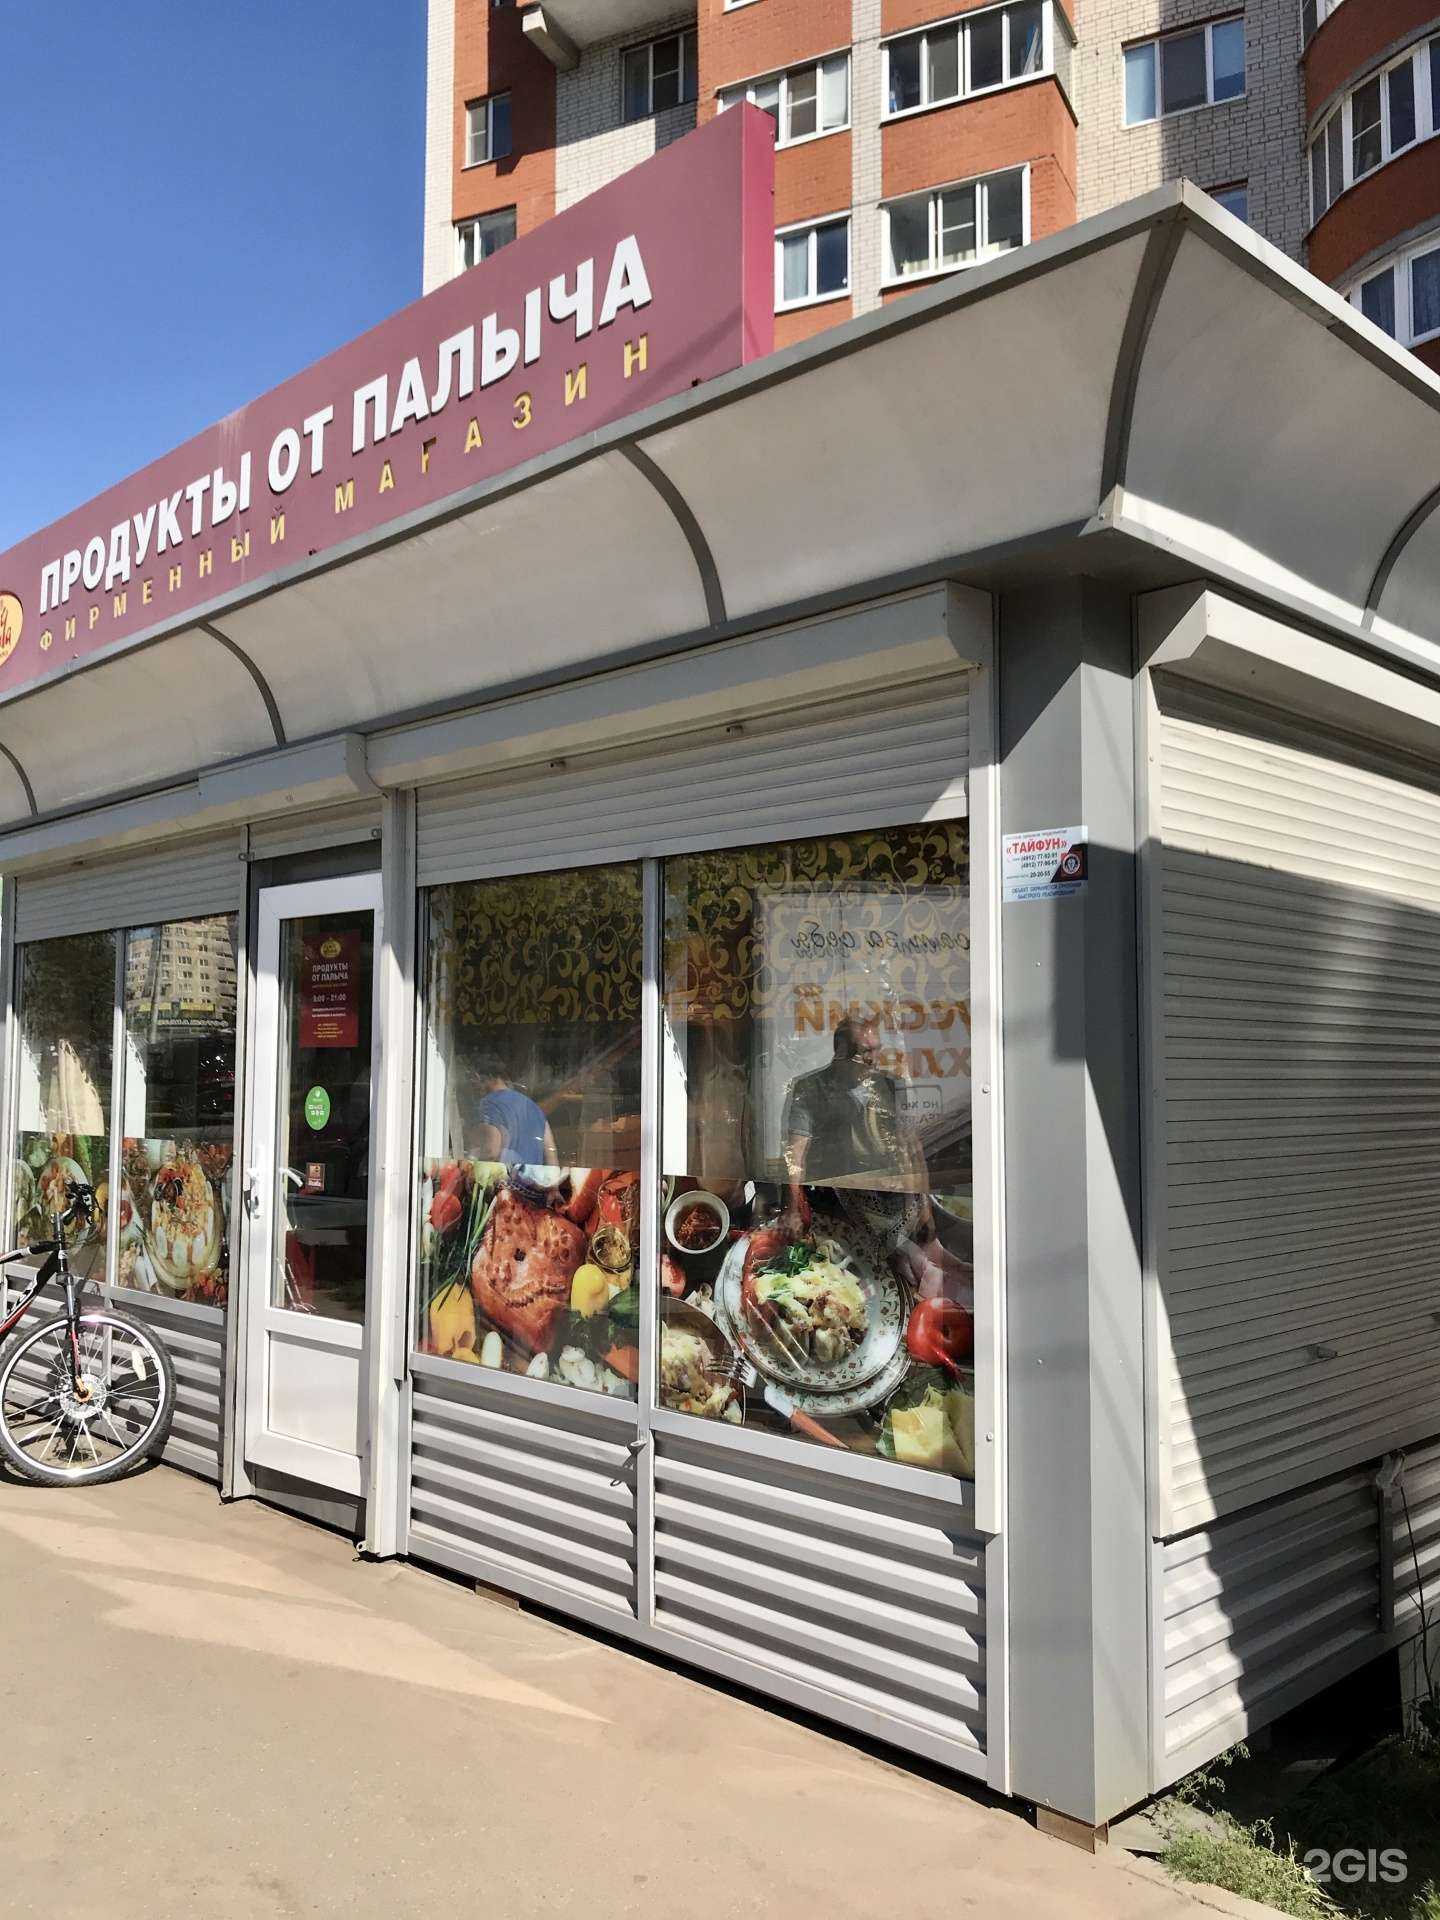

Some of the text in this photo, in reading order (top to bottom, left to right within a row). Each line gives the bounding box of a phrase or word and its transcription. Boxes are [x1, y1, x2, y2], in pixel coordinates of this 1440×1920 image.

[40, 234, 653, 615] ПРОДУКТЫ ОТ ПАЛЫЧА
[40, 334, 648, 651] ФИРМЕННЫЙ МАГАЗИН
[312, 962, 349, 973] ПРОДУКТЫ
[312, 973, 349, 981] ОТ ПАЛЫЧА
